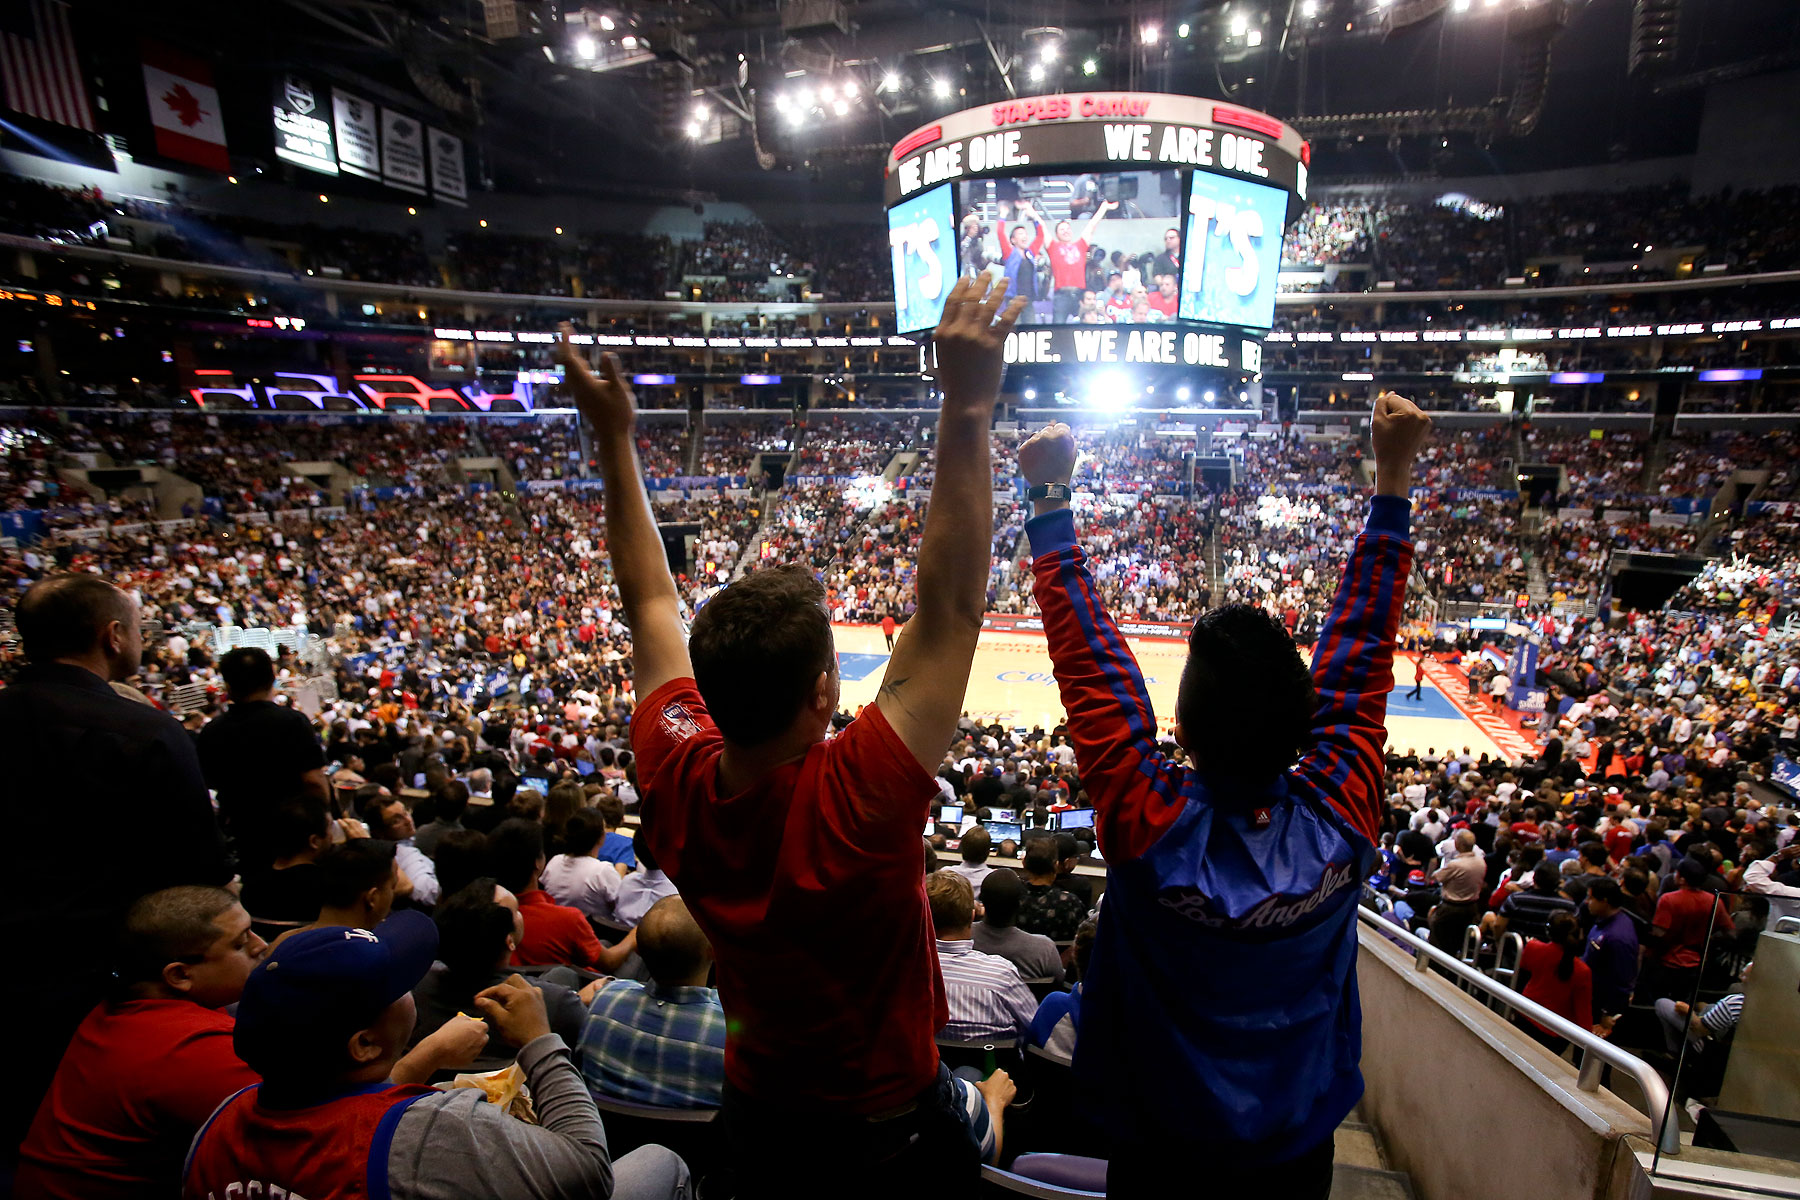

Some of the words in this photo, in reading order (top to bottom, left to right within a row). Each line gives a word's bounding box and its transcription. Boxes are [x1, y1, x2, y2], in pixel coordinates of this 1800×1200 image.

[992, 96, 1072, 126] STAPLES
[1078, 95, 1151, 117] Center
[923, 142, 963, 186] ARE
[969, 130, 1030, 172] ONE.
[1104, 124, 1152, 161] WE
[1159, 125, 1214, 166] ARE
[1220, 133, 1269, 178] ONE.
[1003, 331, 1062, 364] ONE.
[1073, 330, 1118, 363] WE
[1125, 330, 1177, 363] ARE
[1183, 332, 1230, 368] ONE.
[1158, 890, 1224, 929] Los
[1240, 863, 1352, 930] Angeles
